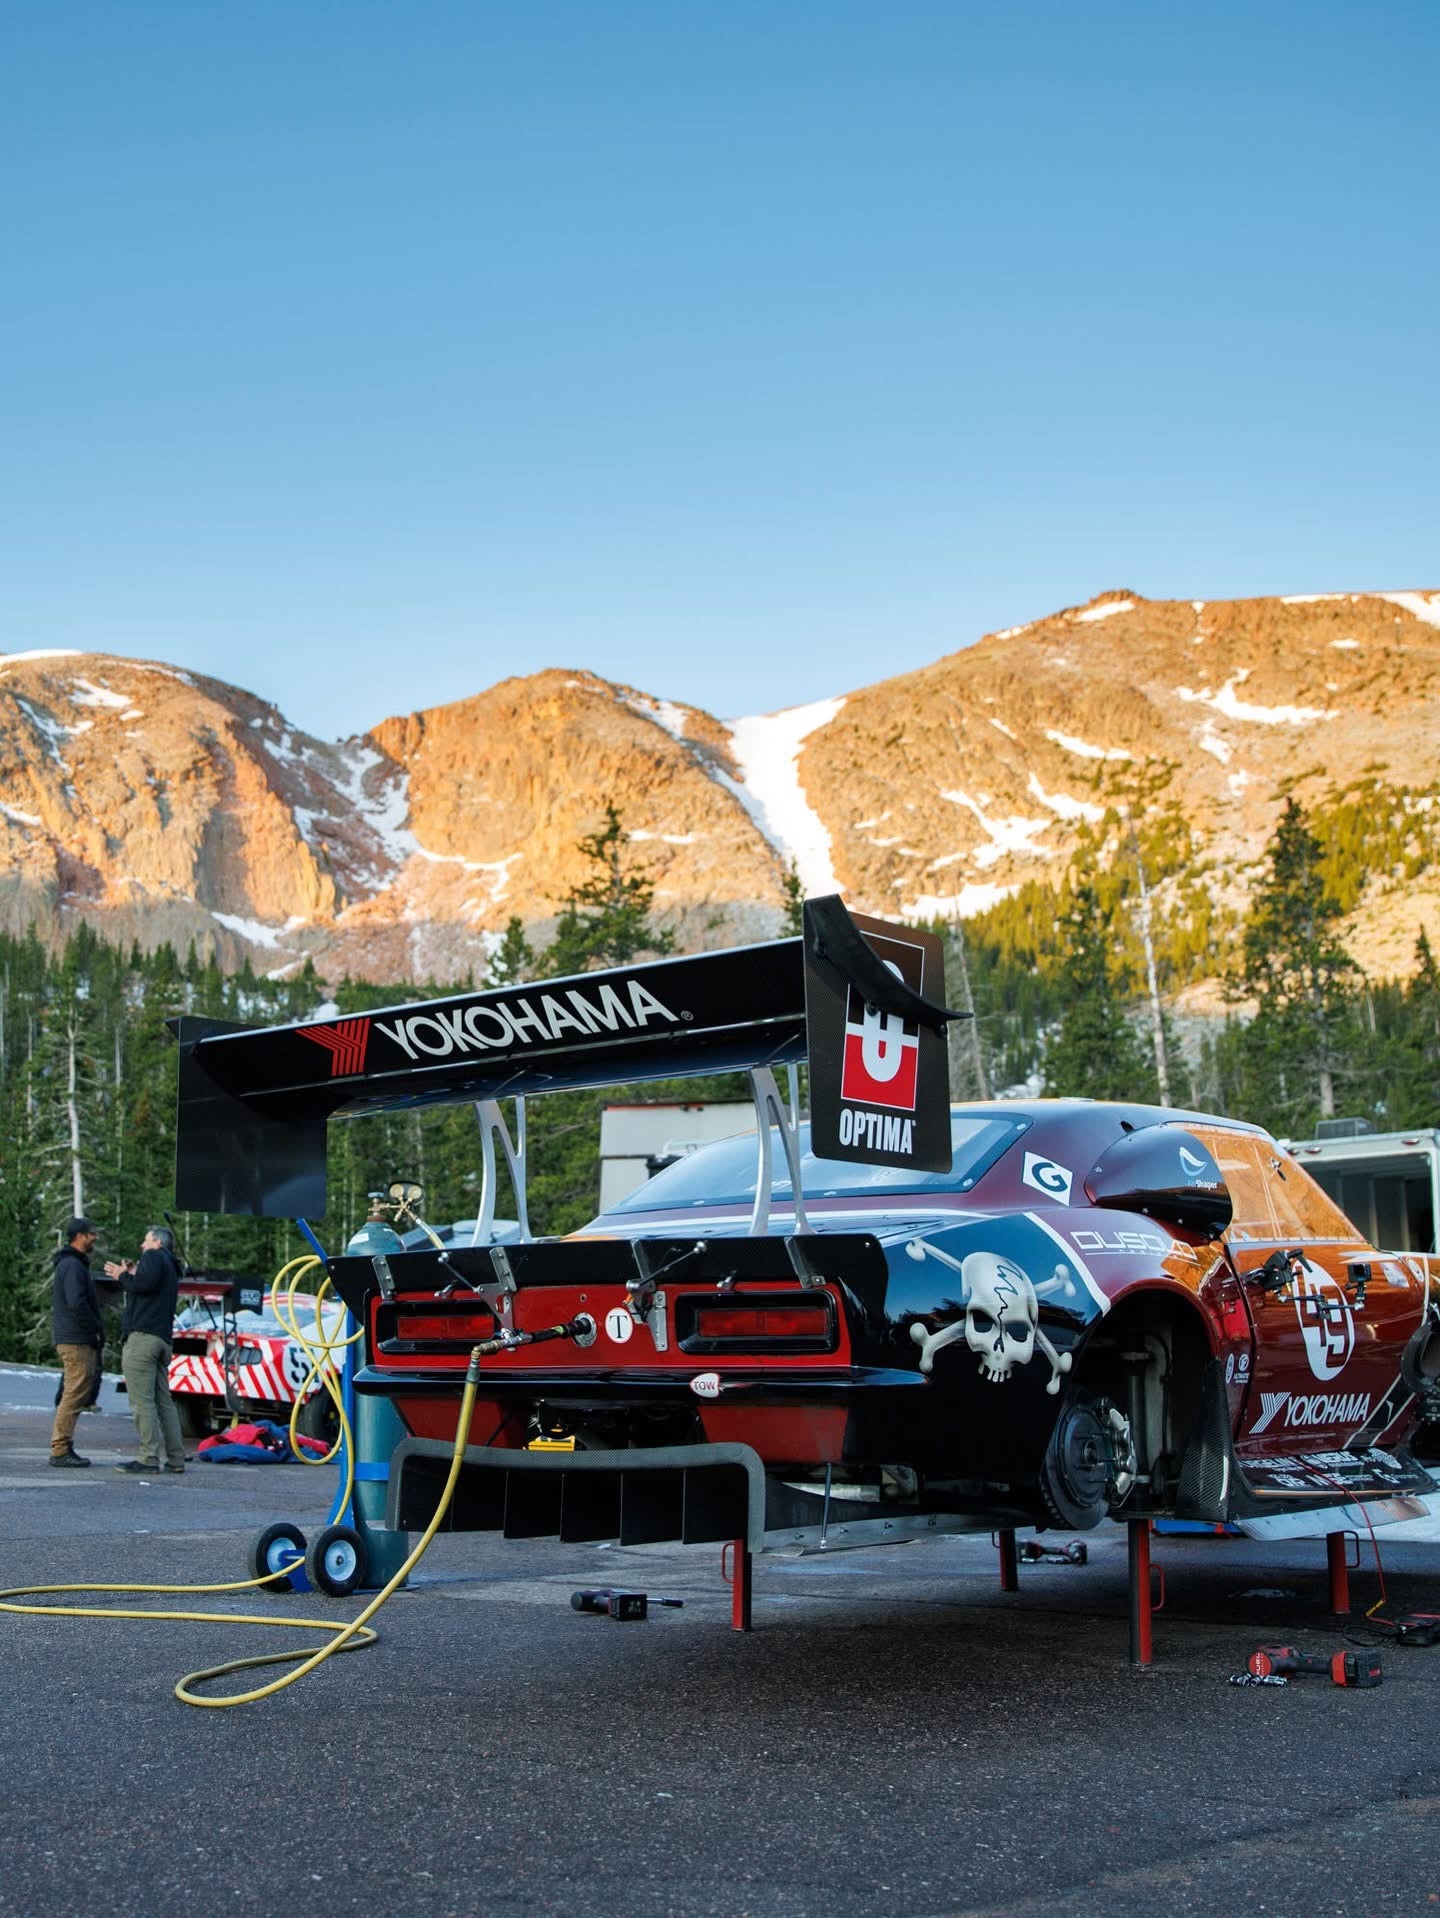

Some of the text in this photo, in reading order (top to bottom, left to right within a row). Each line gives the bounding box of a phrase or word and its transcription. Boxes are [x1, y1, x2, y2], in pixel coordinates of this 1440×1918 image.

[373, 980, 679, 1060] YOKOHAMA
[838, 1107, 914, 1155] OPTIMA
[1031, 1161, 1069, 1192] G
[609, 1314, 629, 1339] T
[693, 1380, 716, 1391] TOW
[1283, 1392, 1371, 1427] YOKOHAMA
